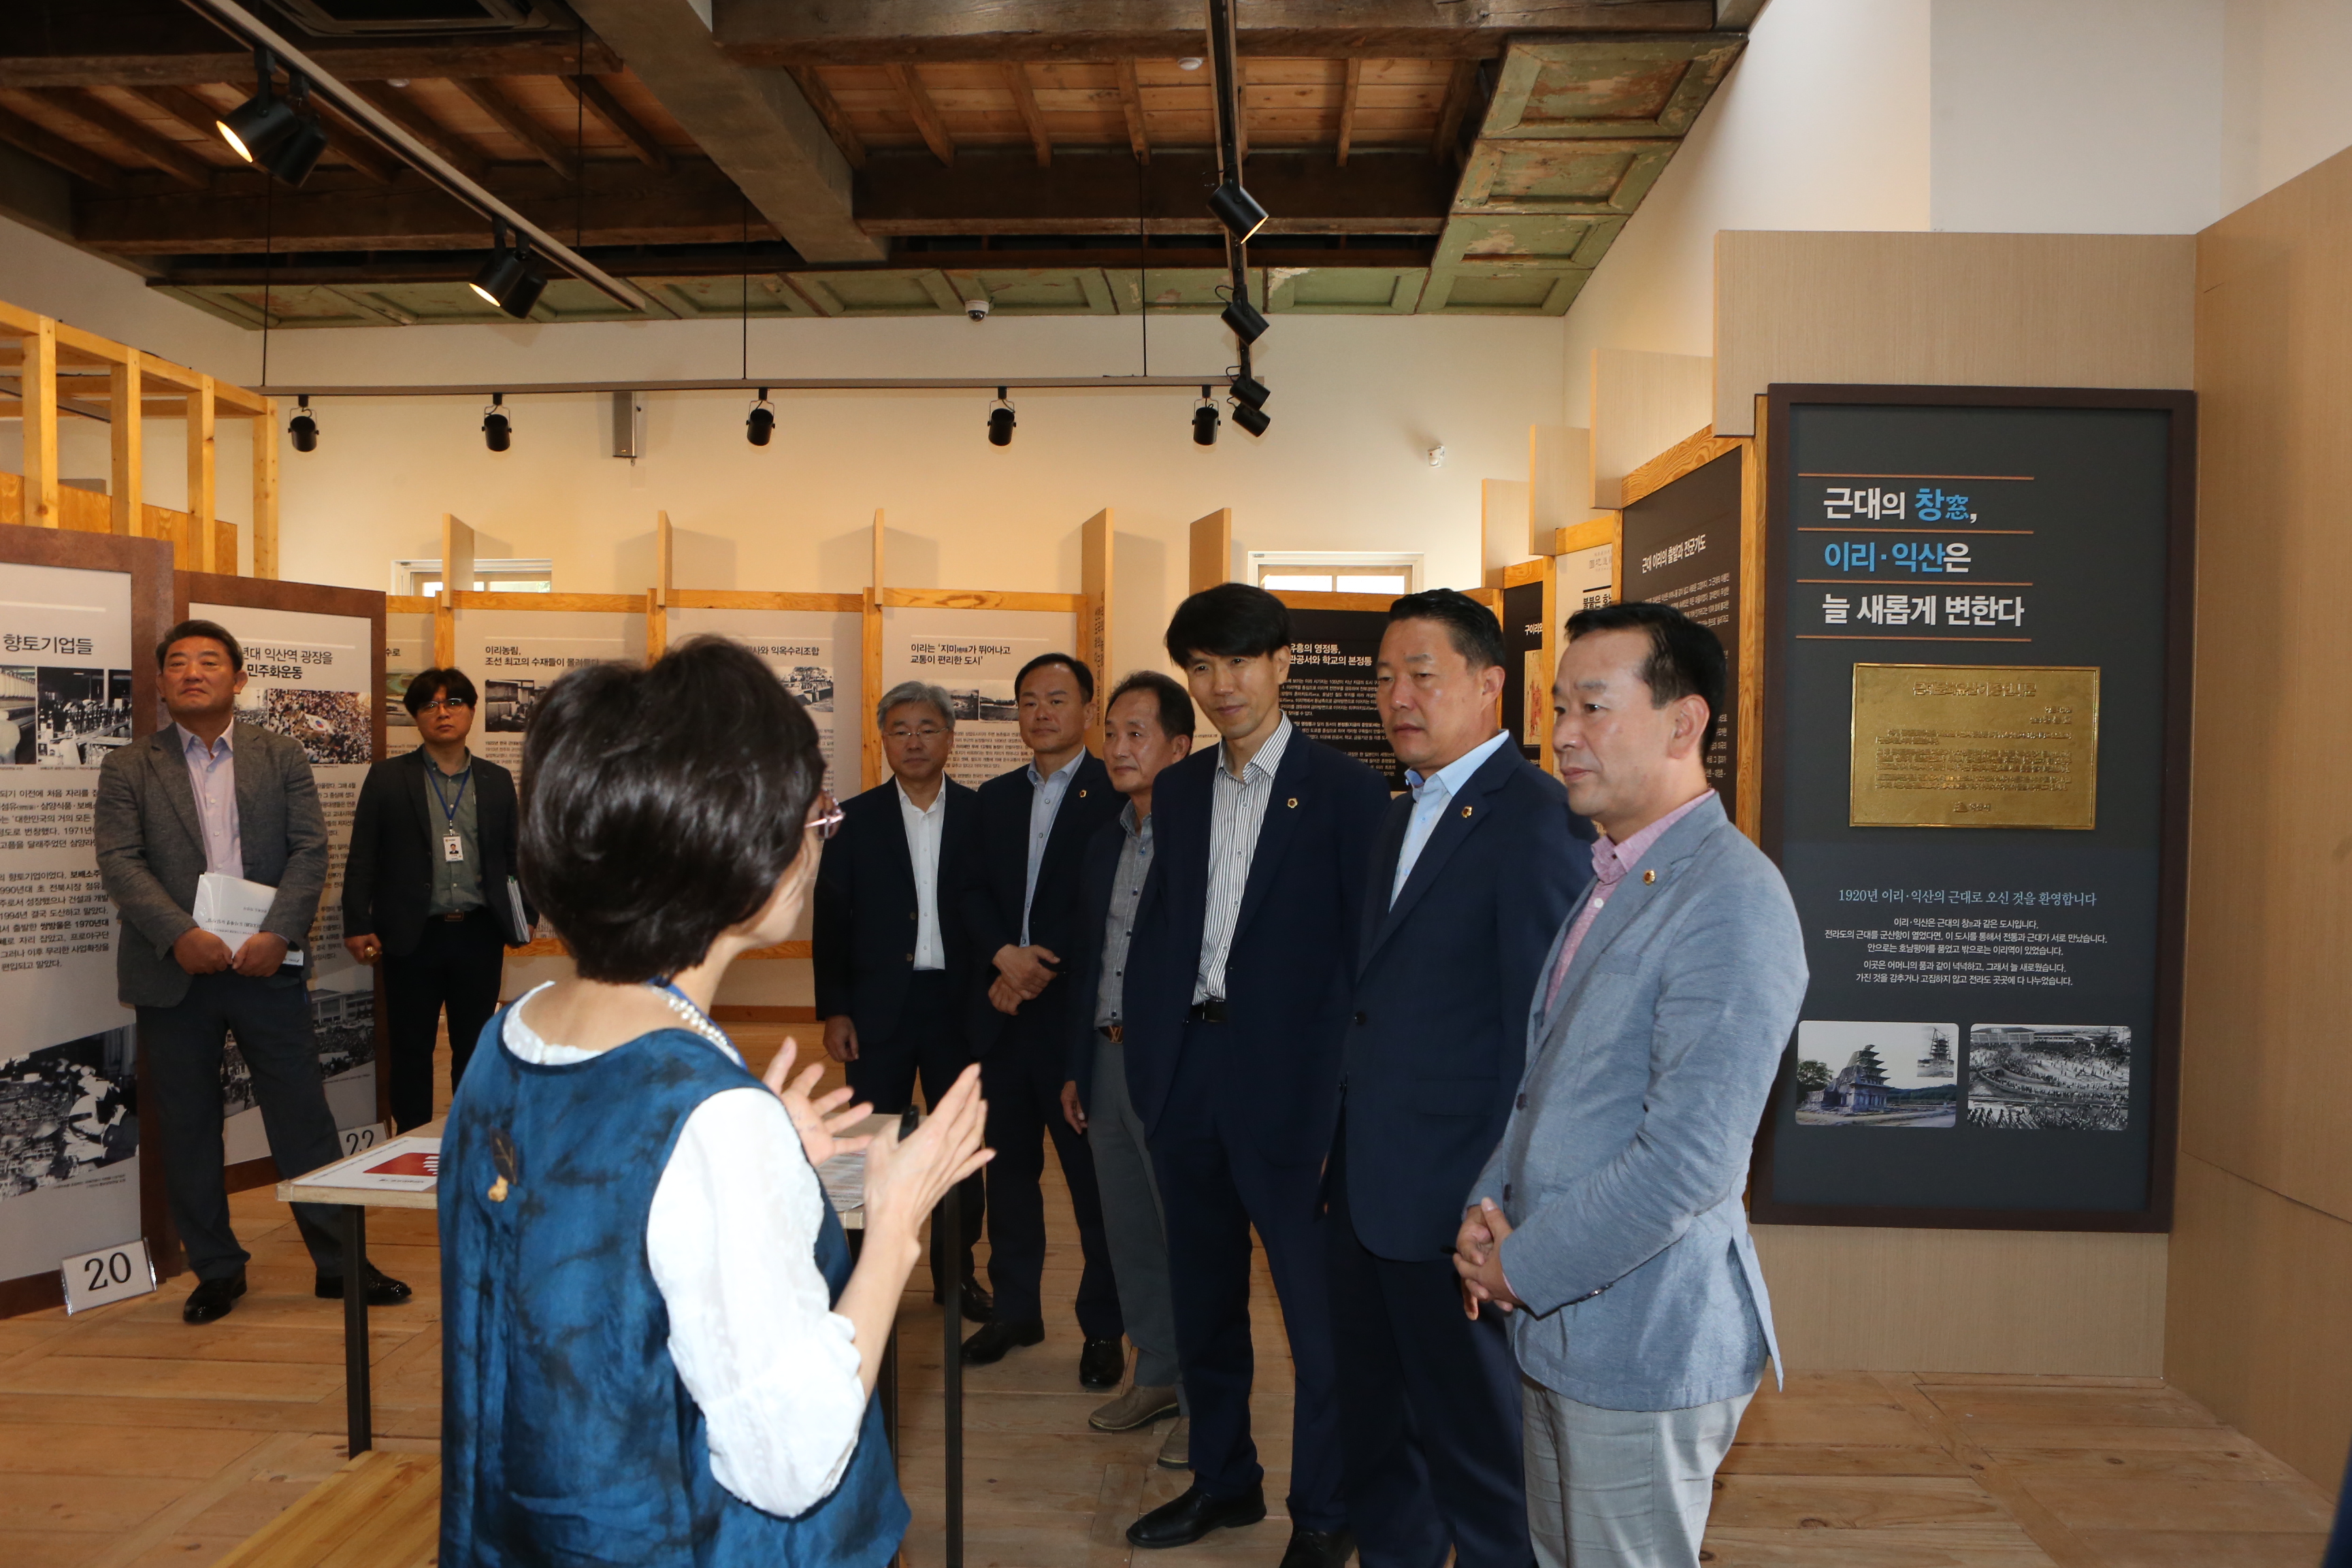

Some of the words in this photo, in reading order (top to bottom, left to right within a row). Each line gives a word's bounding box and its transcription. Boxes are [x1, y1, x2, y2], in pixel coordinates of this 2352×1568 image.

[1823, 487, 1906, 521] 근대의
[1642, 555, 1652, 574] 근대
[1652, 549, 1667, 569] 이리의
[1668, 542, 1683, 564] 출발과
[1684, 534, 1705, 558] 전군가도
[1822, 593, 1850, 625] 늘
[1857, 594, 1937, 626] 새롭게
[1945, 595, 2025, 627] 변한다
[3, 634, 94, 655] 향토기업들
[485, 646, 521, 655] 이리농림,
[911, 643, 935, 653] 이리는
[979, 645, 1011, 655] 뛰어나고
[1314, 644, 1341, 654] 영정통,
[265, 648, 297, 662] 익산역
[301, 651, 333, 664] 광장을
[771, 647, 819, 656] 익옥수리조합
[485, 657, 502, 666] 조선
[504, 657, 529, 666] 최고의
[532, 657, 564, 667] 수재들이
[911, 655, 935, 664] 교통이
[938, 655, 962, 665] 편리한
[1322, 655, 1346, 666] 학교의
[1348, 656, 1372, 666] 본정통
[247, 664, 302, 679] 민주화운동
[20, 789, 43, 798] 이전에
[47, 789, 63, 798] 처음
[66, 789, 88, 798] 자리를
[1839, 889, 1878, 902] 1920년
[1948, 890, 1983, 904] 근대로
[1985, 891, 2009, 904] 오신
[2012, 891, 2036, 906] 것을
[2038, 892, 2097, 906] 환영합니다
[76, 919, 109, 928] 1970년대
[1937, 918, 1960, 928] 근대의
[1983, 919, 1998, 928] 같은
[1999, 919, 2039, 929] 도시입니다.
[70, 931, 109, 941] 프로야구단
[1825, 930, 1855, 939] 전라도의
[1856, 930, 1878, 940] 근대를
[1880, 930, 1910, 941] 군산항이
[1912, 931, 1943, 941] 열었다면,
[1945, 931, 1953, 941] 이
[1955, 932, 1977, 941] 도시를
[1978, 932, 2001, 942] 통해서
[2003, 932, 2026, 942] 전통과
[2027, 932, 2050, 943] 근대가
[2051, 933, 2066, 943] 서로
[2068, 934, 2108, 943] 만났습니다.
[1867, 943, 1897, 953] 안으로는
[1898, 943, 1936, 953] 호남평야를
[1937, 945, 1960, 953] 품었고
[1961, 945, 1991, 954] 밖으로는
[1993, 945, 2023, 955] 이리역이
[2024, 946, 2063, 956] 있었습니다.
[1863, 960, 1886, 970] 이곳은
[1887, 961, 1917, 970] 어머니의
[1918, 961, 1934, 970] 품과
[1936, 962, 1950, 970] 같이
[1953, 962, 1984, 971] 넉넉하고,
[1986, 962, 2009, 972] 그래서
[2010, 962, 2018, 972] 늘
[2019, 963, 2066, 973] 새로웠습니다.
[1856, 973, 1872, 982] 가진
[1873, 973, 1888, 983] 것을
[1889, 974, 1919, 983] 감추거나
[1921, 974, 1950, 983] 고집하지
[1953, 975, 1967, 984] 않고
[1969, 975, 1991, 985] 전라도
[1993, 975, 2016, 985] 곳곳에
[2017, 976, 2025, 985] 다
[2027, 976, 2073, 986] 나누었습니다.
[84, 1252, 132, 1292] 20
